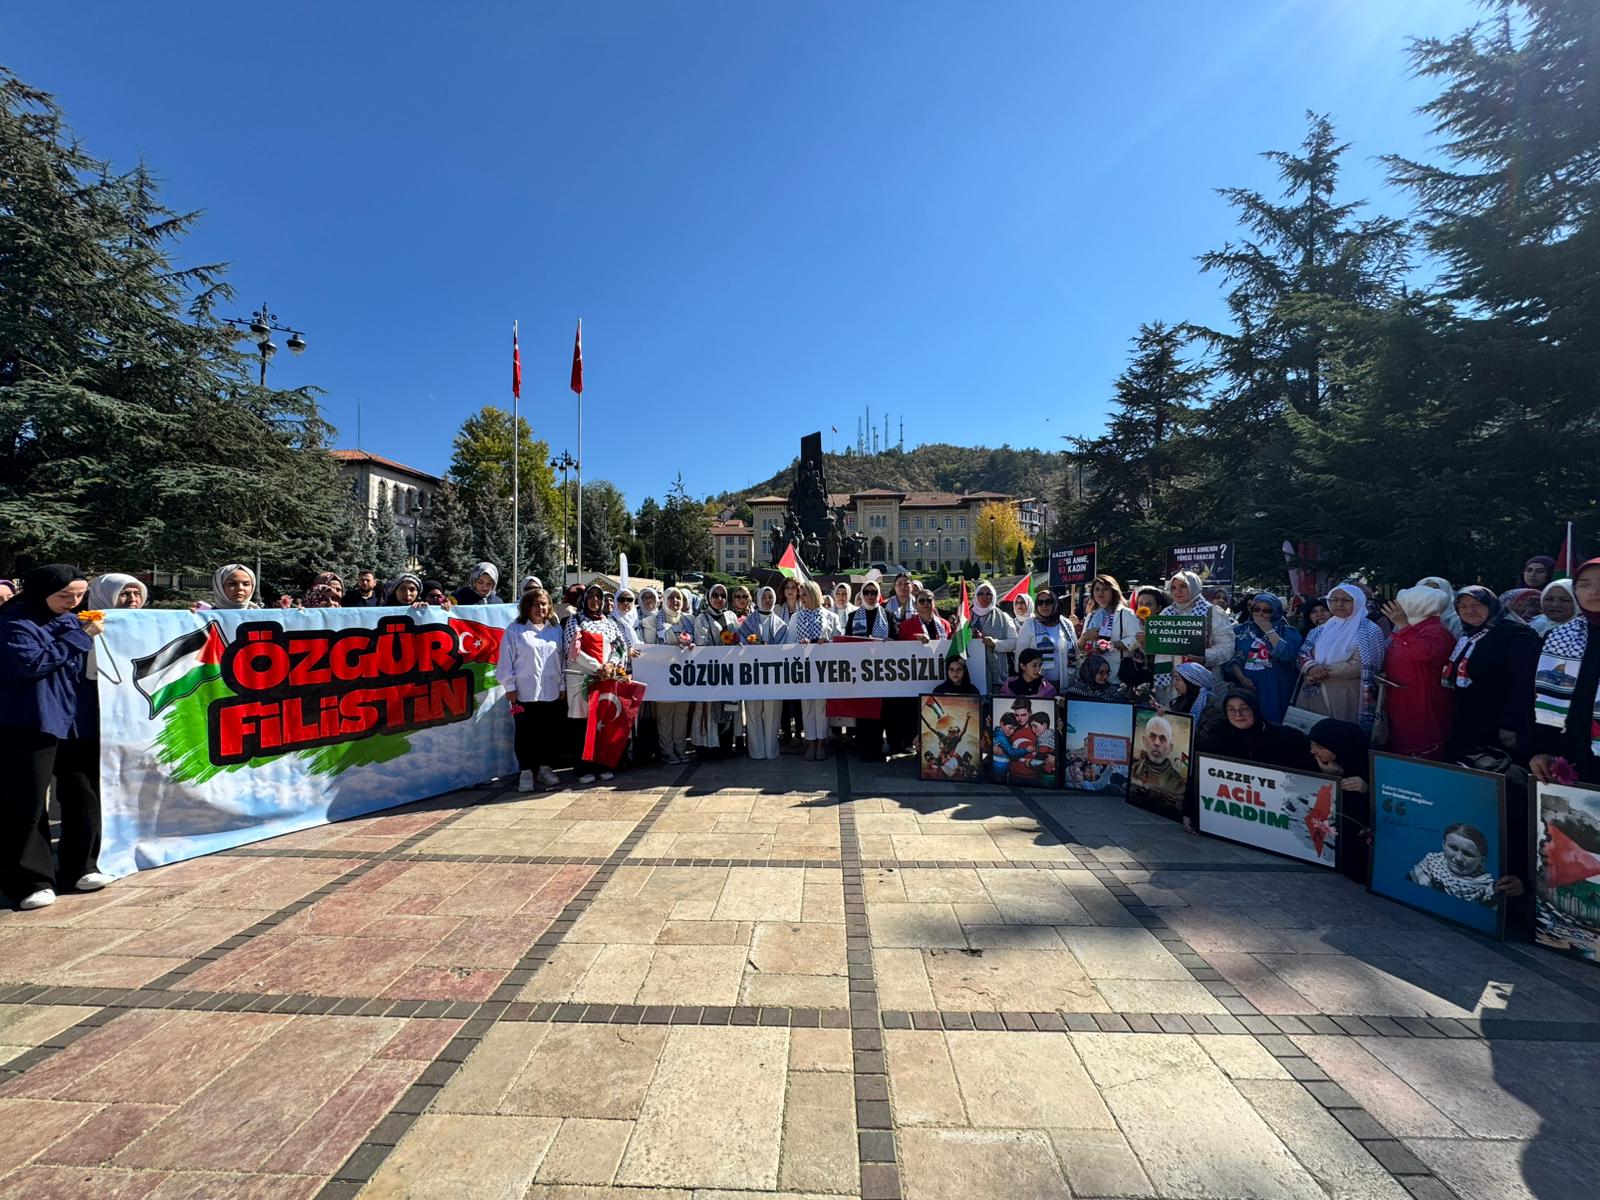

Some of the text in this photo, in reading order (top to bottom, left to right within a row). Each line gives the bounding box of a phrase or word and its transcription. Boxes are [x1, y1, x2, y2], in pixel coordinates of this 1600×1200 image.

[1067, 564, 1087, 573] KADIN
[1158, 637, 1191, 645] TARAFIZ.
[233, 624, 456, 690] ÖZGÜR
[669, 653, 946, 686] SÖZÜN BİTTİĞİ YER; SESSİZLİ
[1216, 783, 1266, 807] ACİL
[1201, 795, 1290, 830] YARDIM
